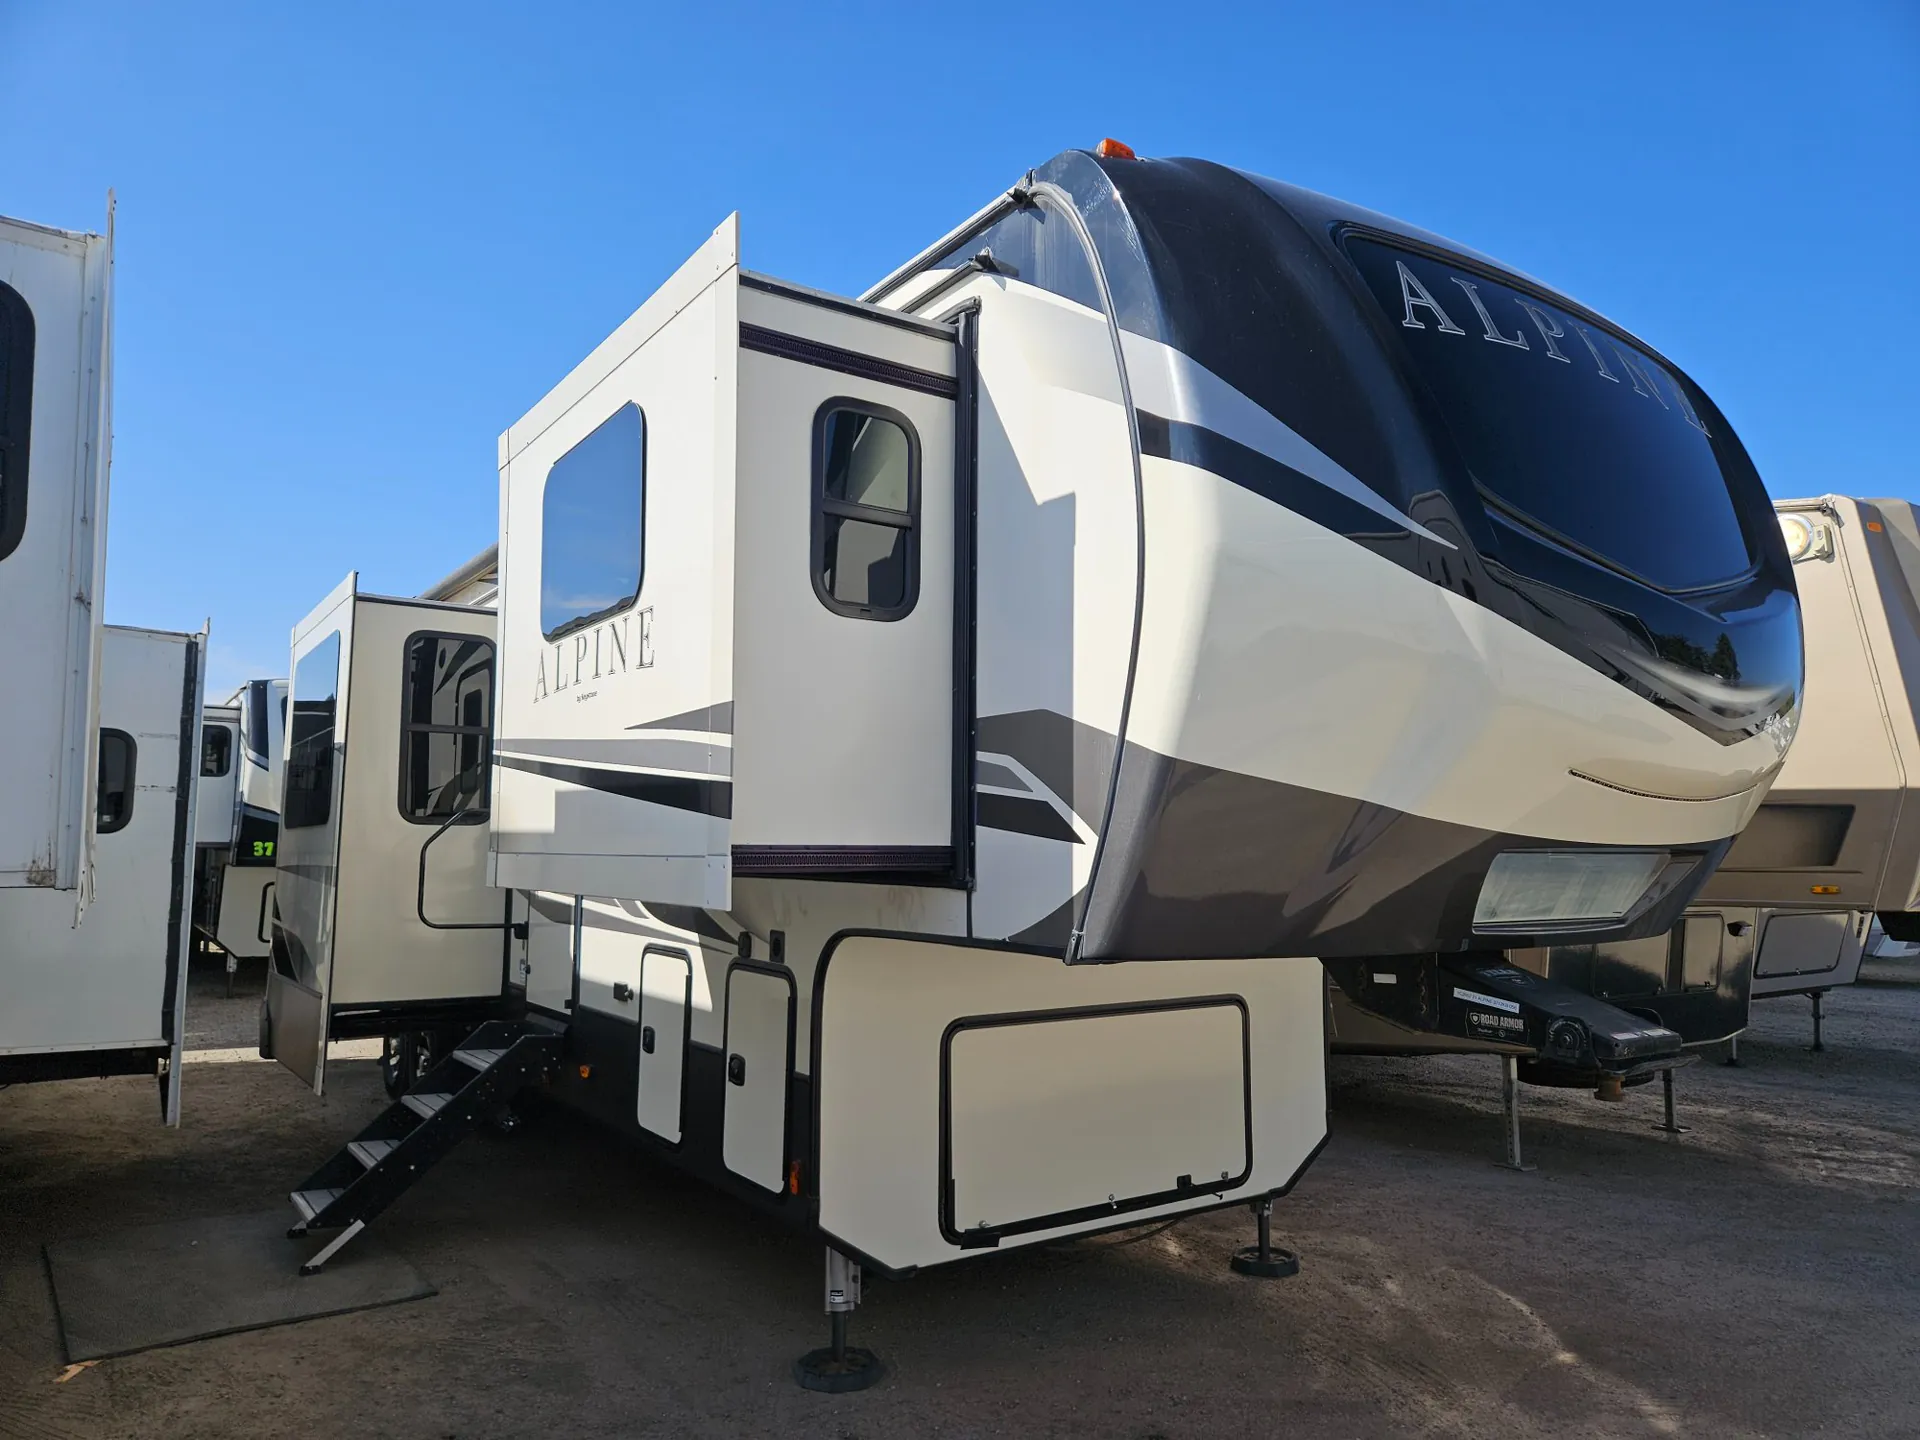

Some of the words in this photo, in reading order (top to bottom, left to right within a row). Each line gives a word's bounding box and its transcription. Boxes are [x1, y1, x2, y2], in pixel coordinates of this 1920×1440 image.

[533, 606, 655, 703] ALPINE
[253, 841, 274, 856] 37
[1480, 1013, 1499, 1026] ROAD
[1500, 1016, 1524, 1030] ARMOR
